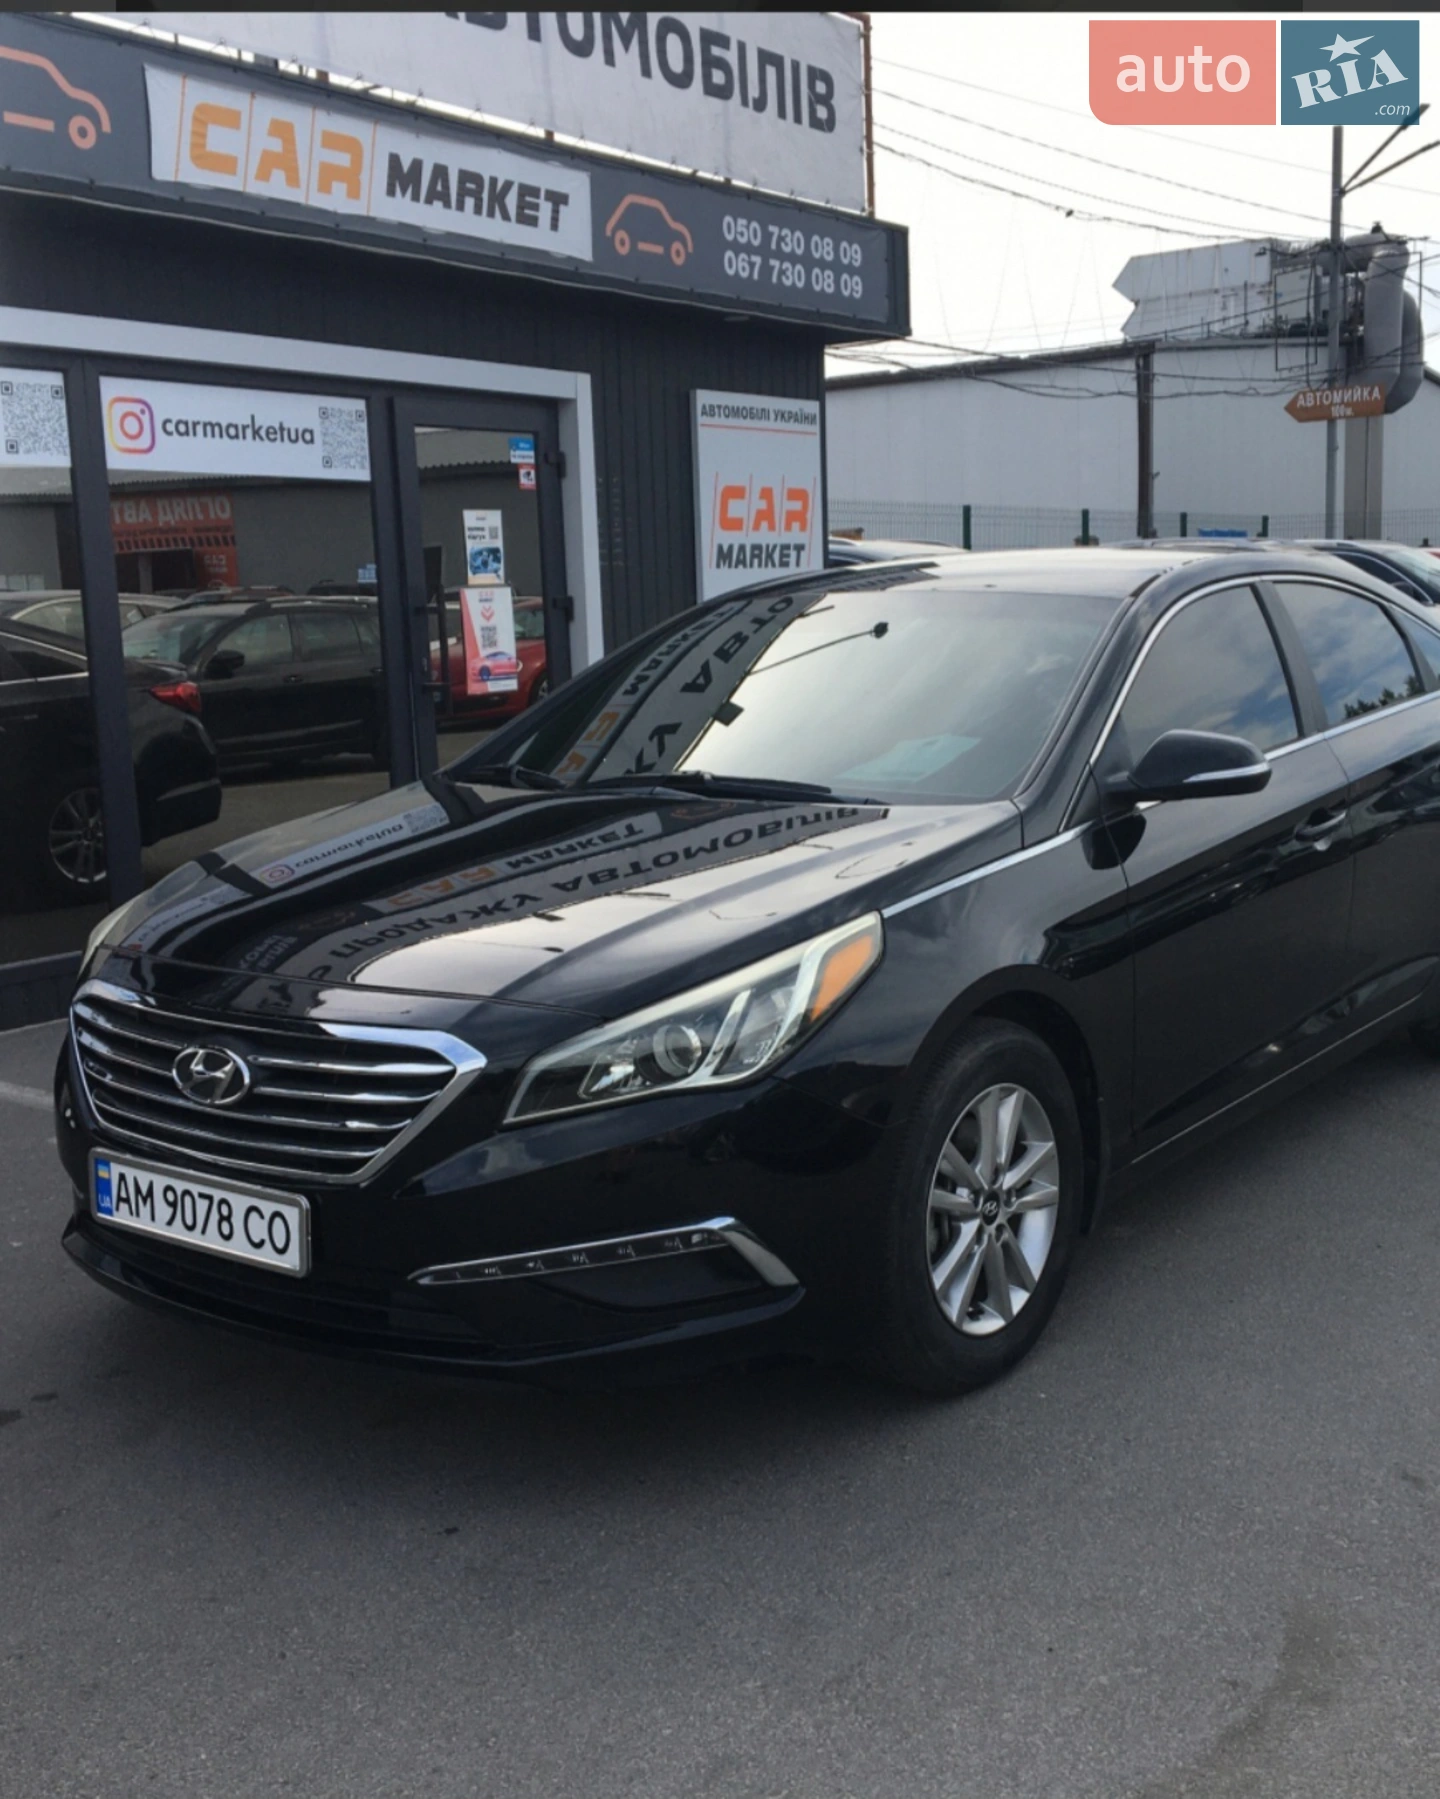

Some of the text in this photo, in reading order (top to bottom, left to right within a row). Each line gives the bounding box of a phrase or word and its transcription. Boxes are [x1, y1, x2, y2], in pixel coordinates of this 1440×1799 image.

[444, 12, 837, 133] ОМОБІЛІВ
[189, 102, 570, 232] CAR MARKET
[722, 215, 862, 267] 050 730 08 09
[724, 250, 863, 298] 067 730 08 09
[701, 404, 817, 425] АВТОМОБІЛІ УКРАЇНИ
[1297, 385, 1381, 408] АВТОМИЙКА
[161, 414, 315, 445] carmarketua
[719, 485, 810, 532] CAR
[715, 543, 805, 569] MARKET
[115, 1172, 291, 1255] AM 9078 CO
